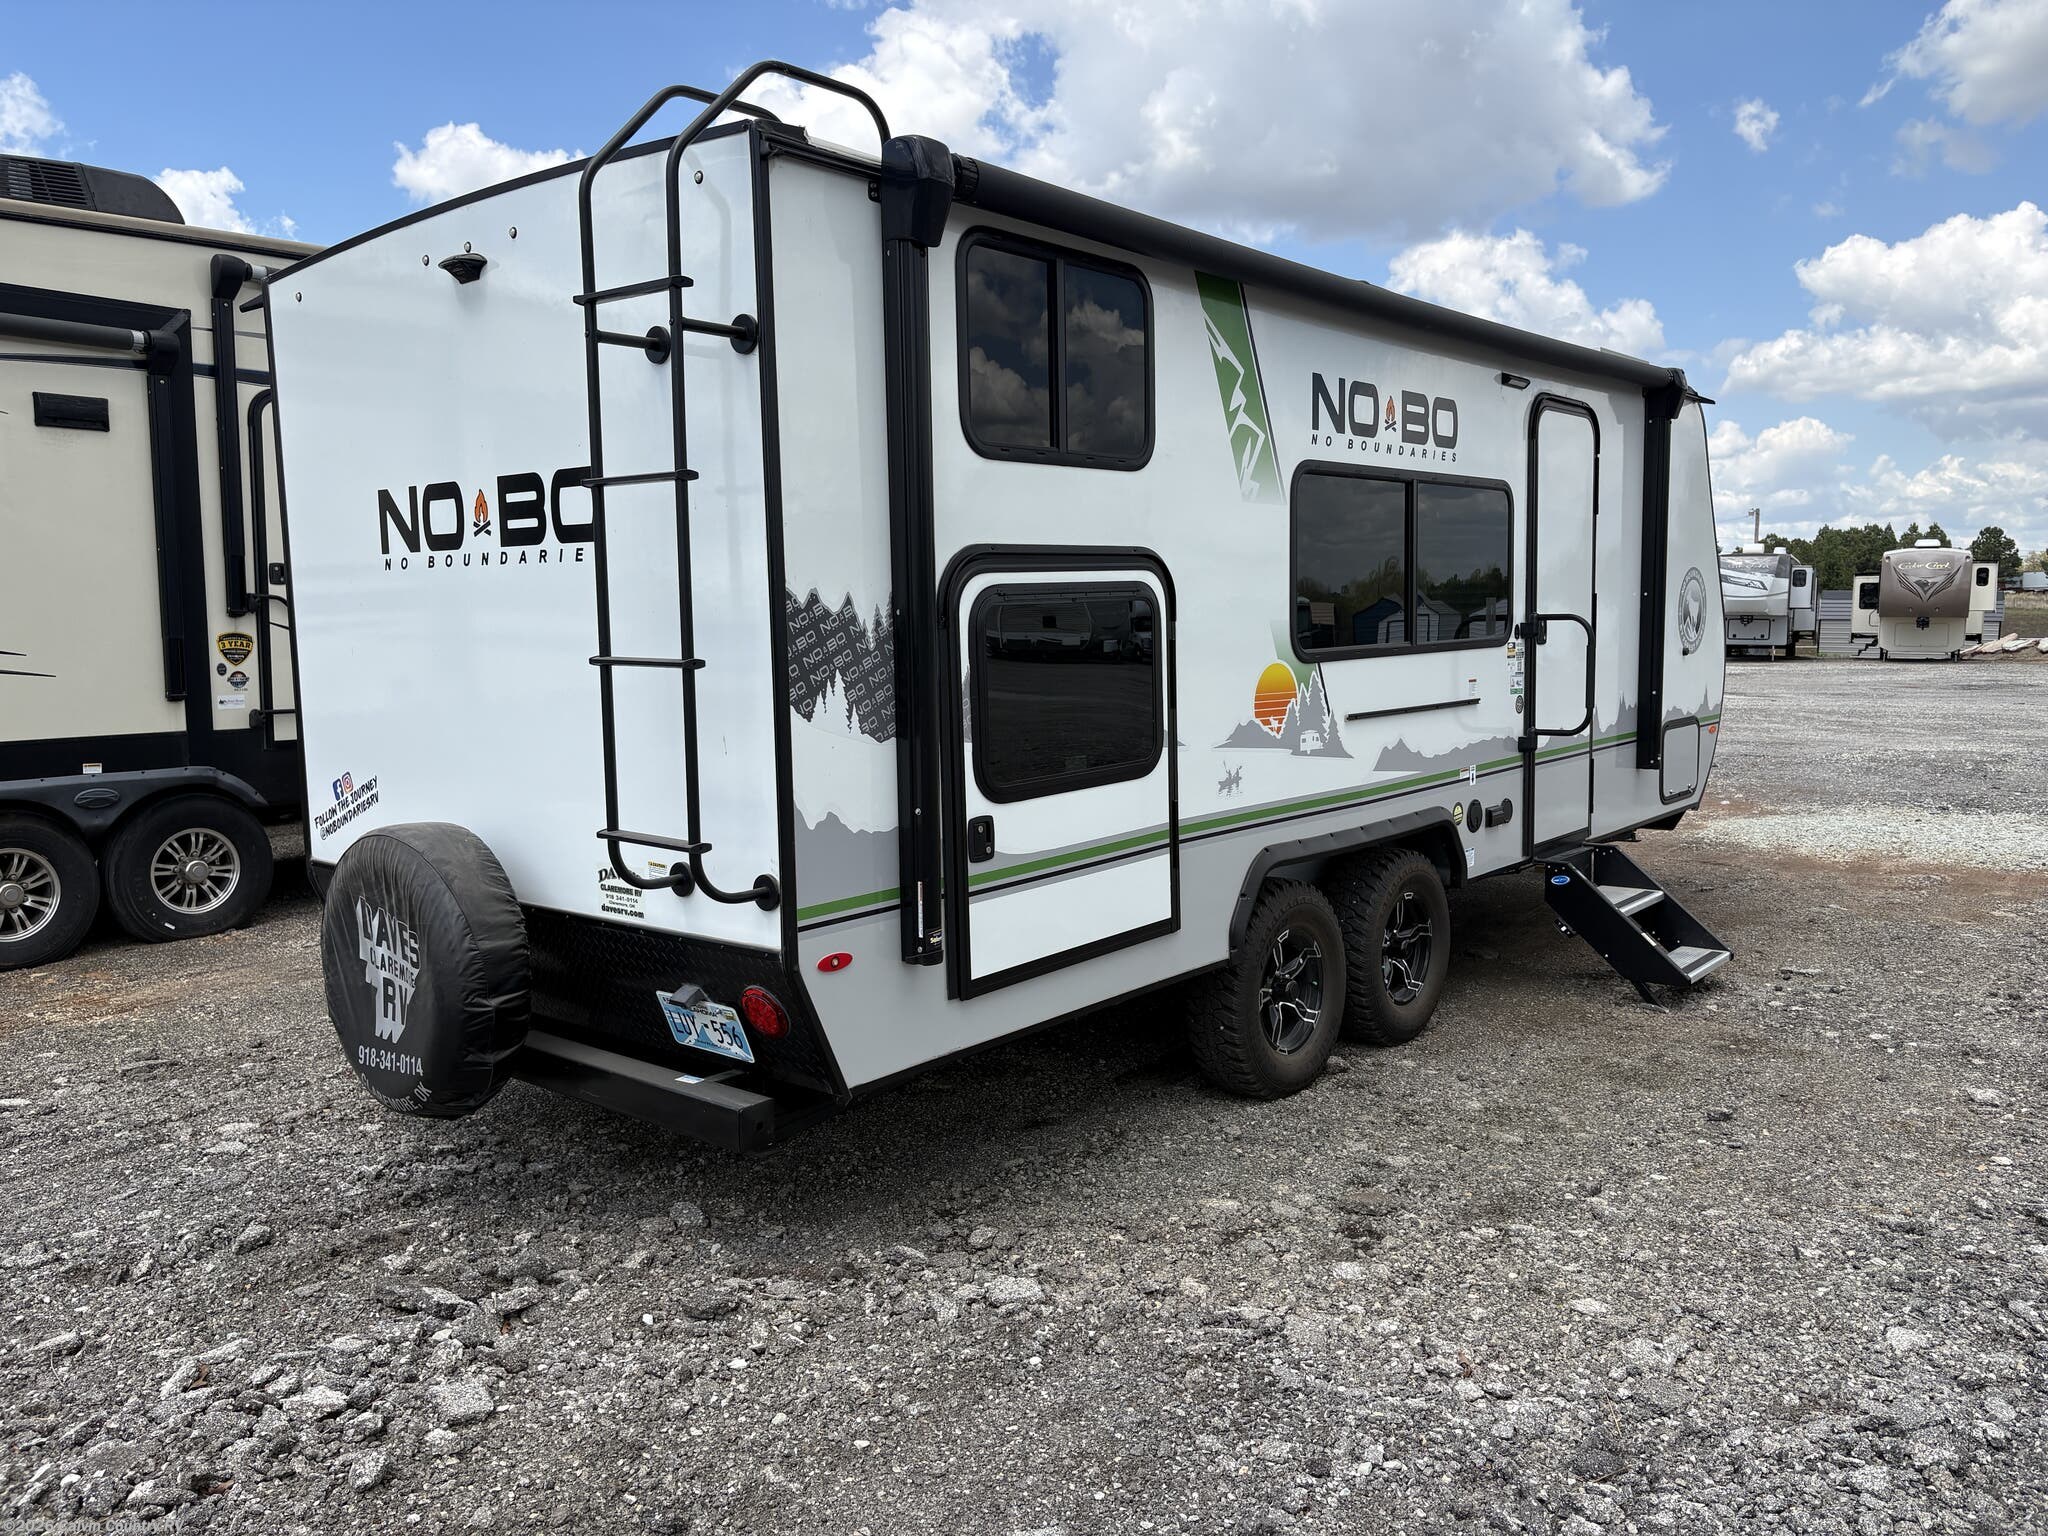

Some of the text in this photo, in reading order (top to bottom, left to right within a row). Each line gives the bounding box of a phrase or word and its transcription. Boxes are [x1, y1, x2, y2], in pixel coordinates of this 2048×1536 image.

[1312, 372, 1458, 449] NO BO
[1311, 434, 1457, 462] NO BOUNDARIES
[378, 481, 464, 554] NO
[384, 548, 585, 571] NO BOUNDARIE
[228, 640, 251, 648] YEAR
[314, 775, 378, 829] FOLLOW THE JOURNEY
[320, 791, 379, 840] @NOBOUNDARIESRV
[600, 883, 643, 897] CLAREMORE RV
[601, 903, 645, 919] davesrv.com
[358, 896, 421, 970] DAVES
[382, 976, 408, 1026] RV
[668, 1009, 744, 1050] LUY-556
[358, 1044, 424, 1077] 918-341-0114
[414, 1081, 432, 1102] OK
